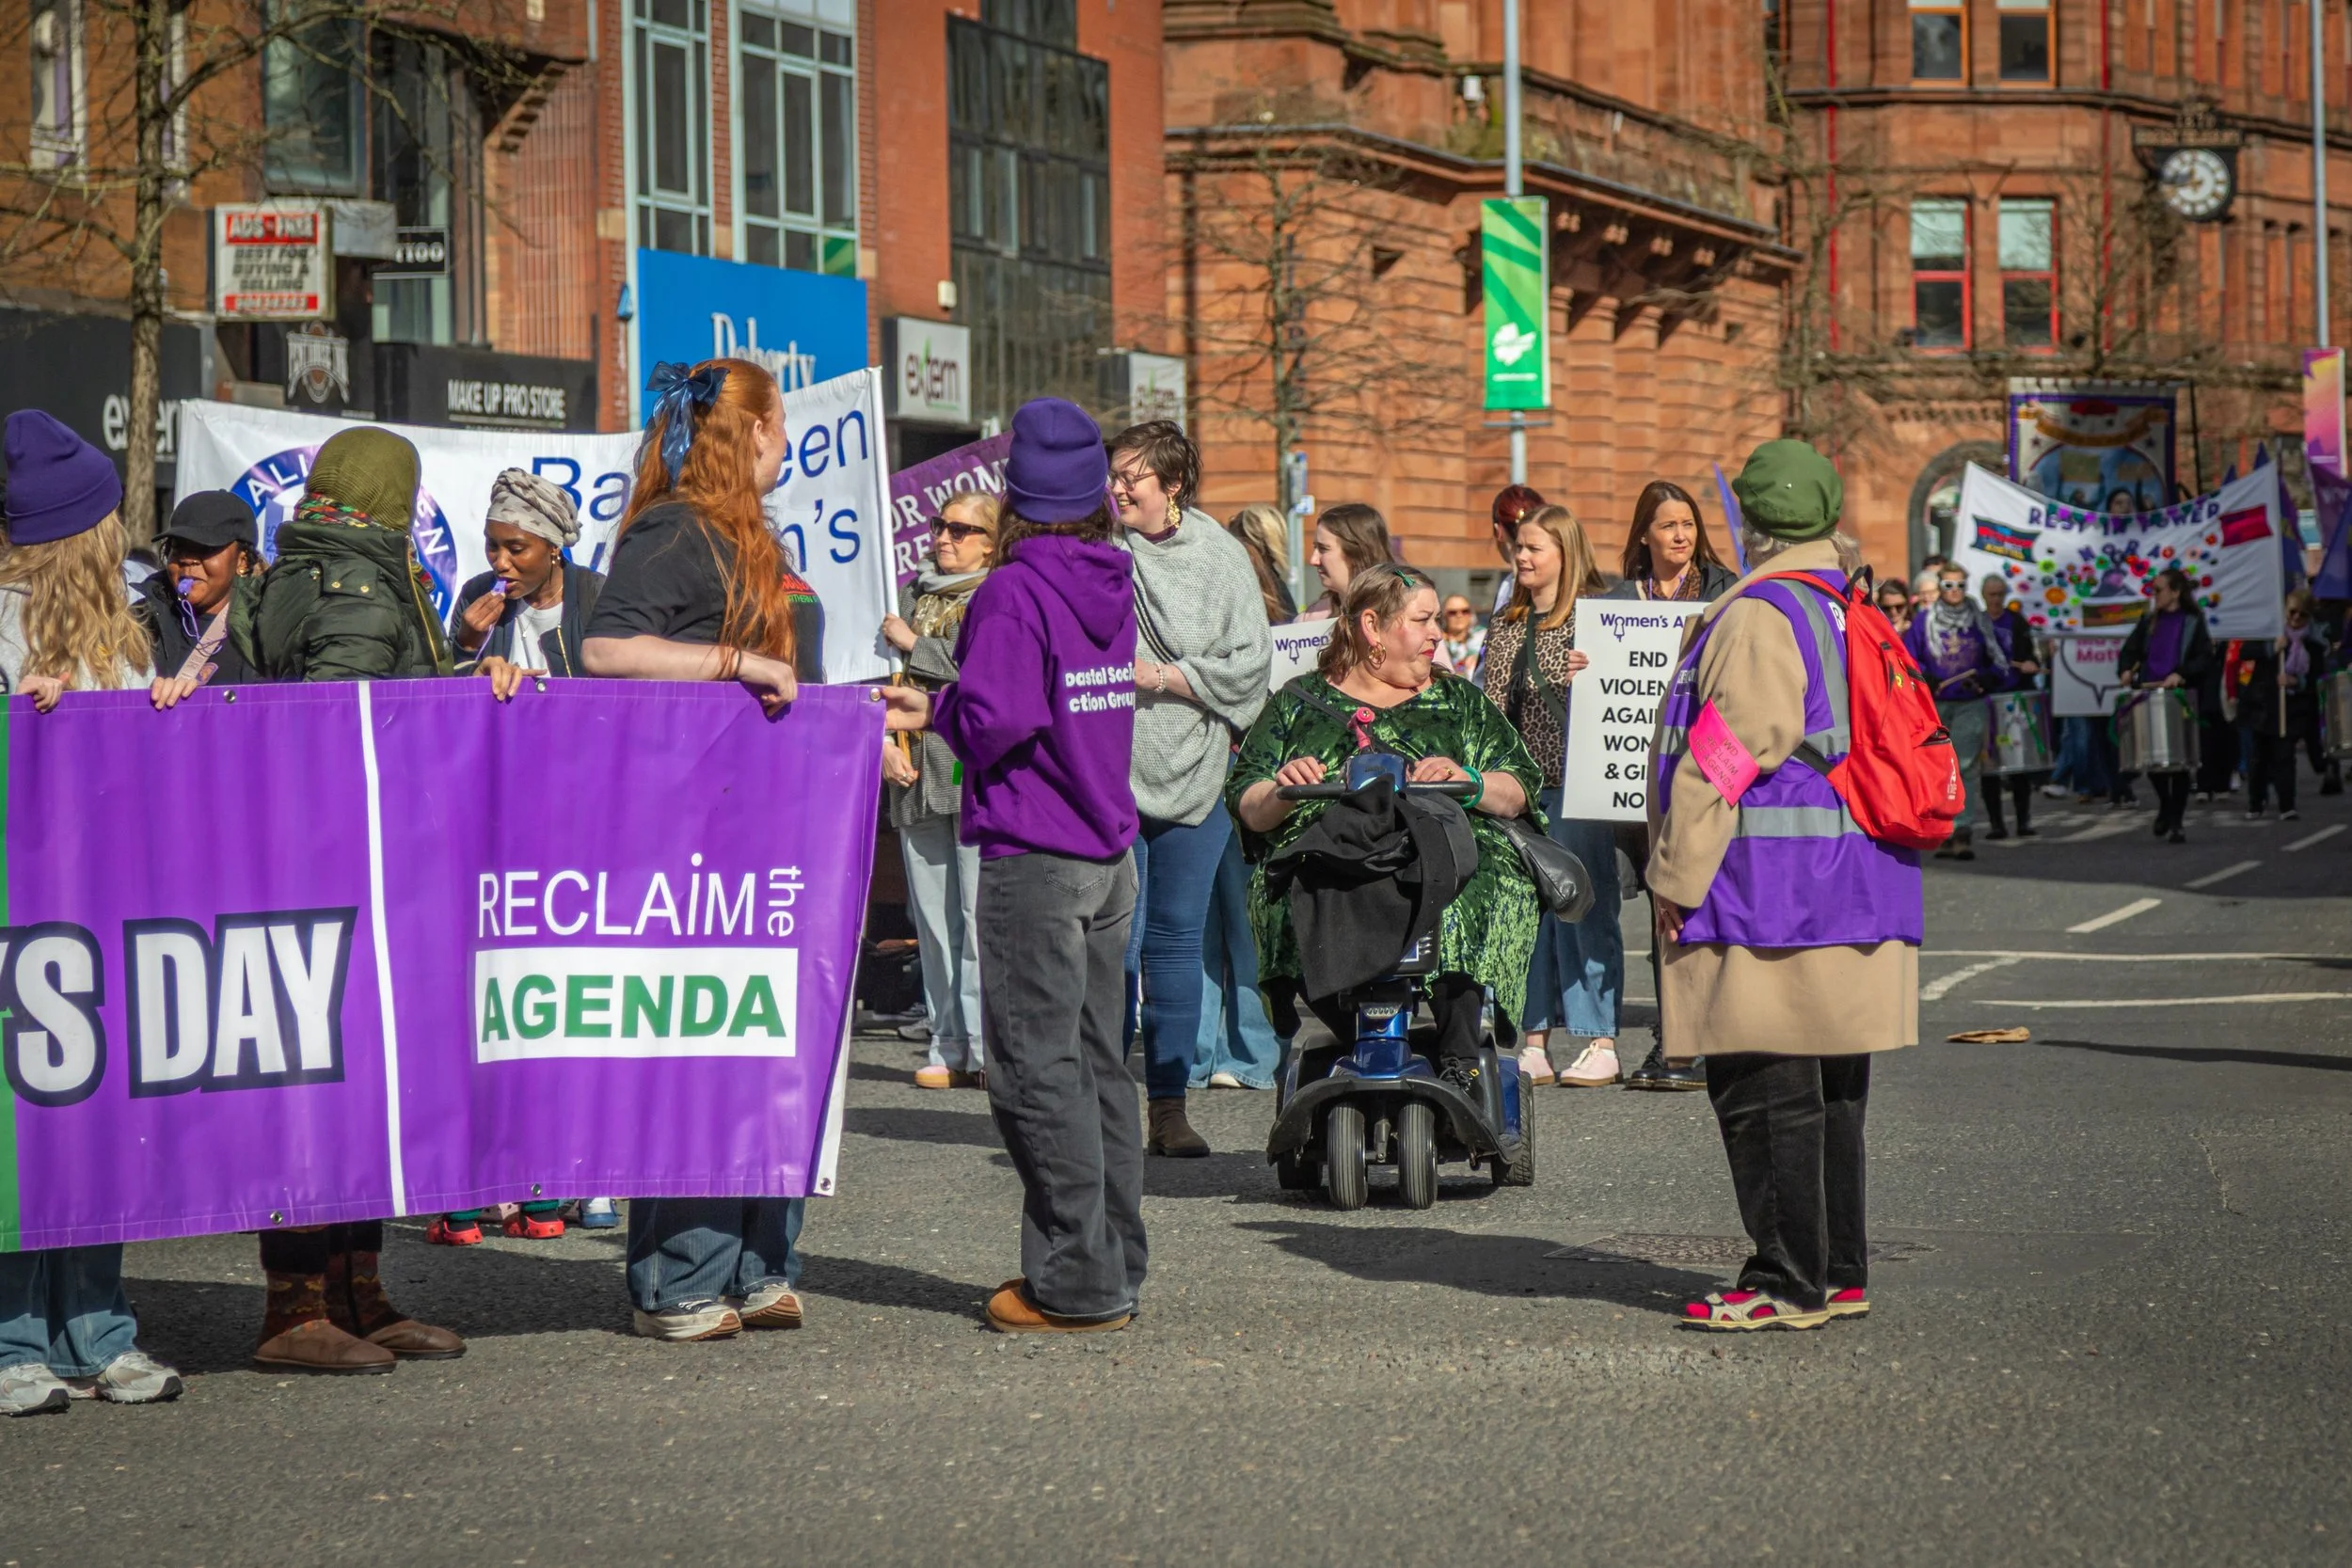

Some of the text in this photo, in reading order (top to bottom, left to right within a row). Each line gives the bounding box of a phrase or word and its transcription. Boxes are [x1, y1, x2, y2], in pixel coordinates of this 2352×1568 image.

[447, 379, 566, 420] MAKE UP PRO STORE
[1599, 612, 1669, 637] Women's
[1629, 650, 1669, 668] END
[1601, 706, 1658, 724] AGAI
[1604, 763, 1620, 780] &
[767, 864, 805, 938] the
[135, 921, 344, 1084] DAY
[481, 974, 787, 1044] AGENDA
